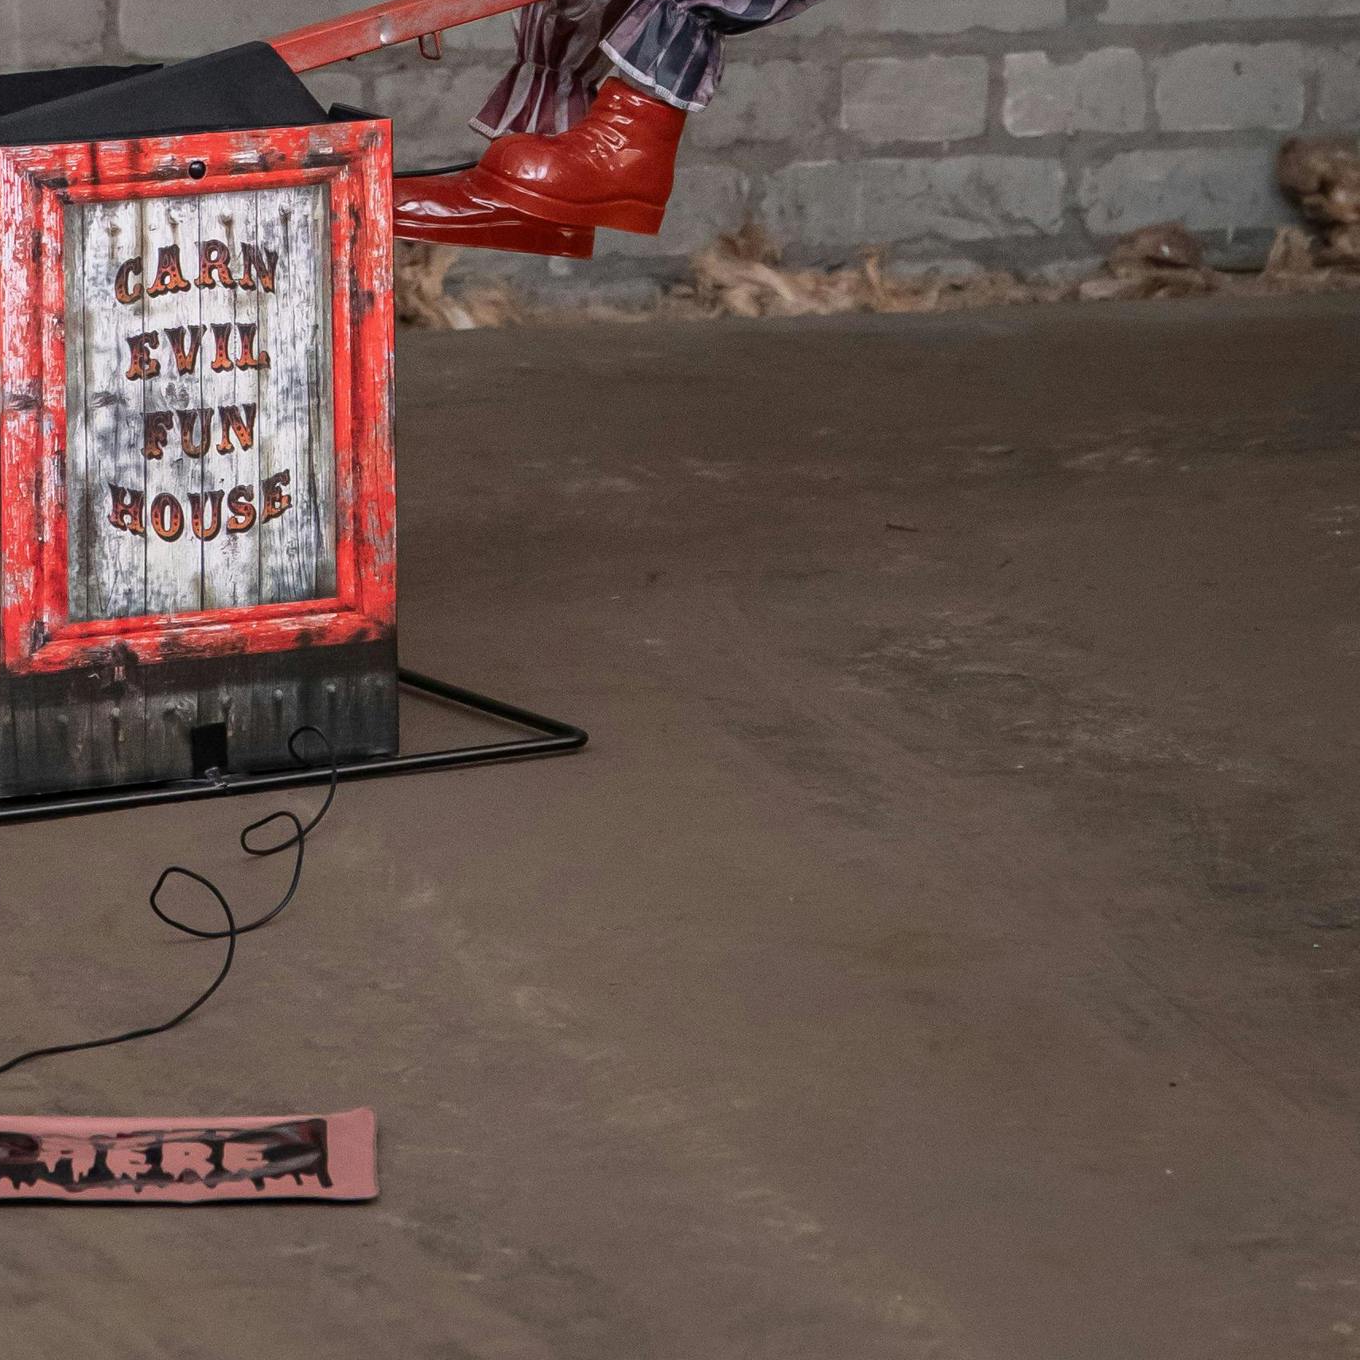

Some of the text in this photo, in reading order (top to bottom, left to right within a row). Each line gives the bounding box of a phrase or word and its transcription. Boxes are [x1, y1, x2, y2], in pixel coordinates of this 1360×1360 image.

[114, 239, 279, 305] CARN
[125, 322, 271, 381] EVIL
[141, 403, 257, 460] FUN
[108, 469, 292, 542] HOUSE
